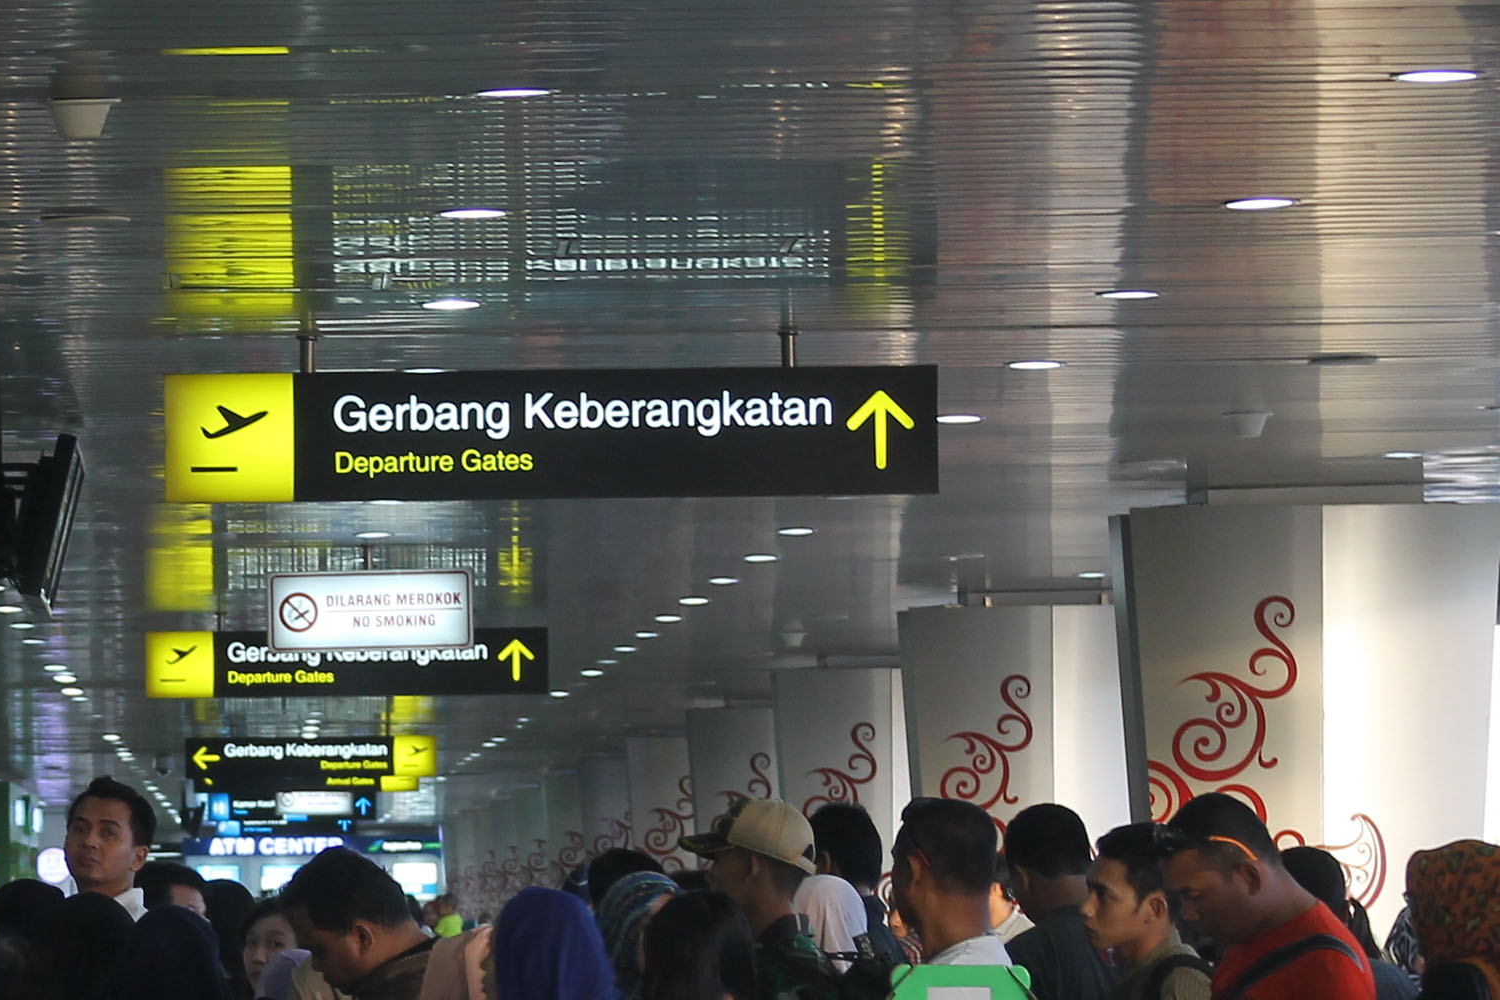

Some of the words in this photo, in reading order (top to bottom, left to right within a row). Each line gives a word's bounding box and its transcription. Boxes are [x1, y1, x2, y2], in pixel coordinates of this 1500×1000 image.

[332, 394, 511, 440] Gerbang
[523, 390, 834, 437] Keberangkatan
[333, 451, 456, 479] Departure
[459, 448, 534, 473] Gates
[325, 593, 391, 608] DILARANG
[395, 591, 462, 606] MEROKOK
[352, 615, 370, 628] NO
[375, 613, 436, 627] SMOKING
[227, 670, 293, 687] Departure
[294, 669, 335, 685] Gates
[223, 742, 284, 761] Gerbang
[285, 742, 389, 760] Keberangkatan
[209, 837, 255, 856] ATM
